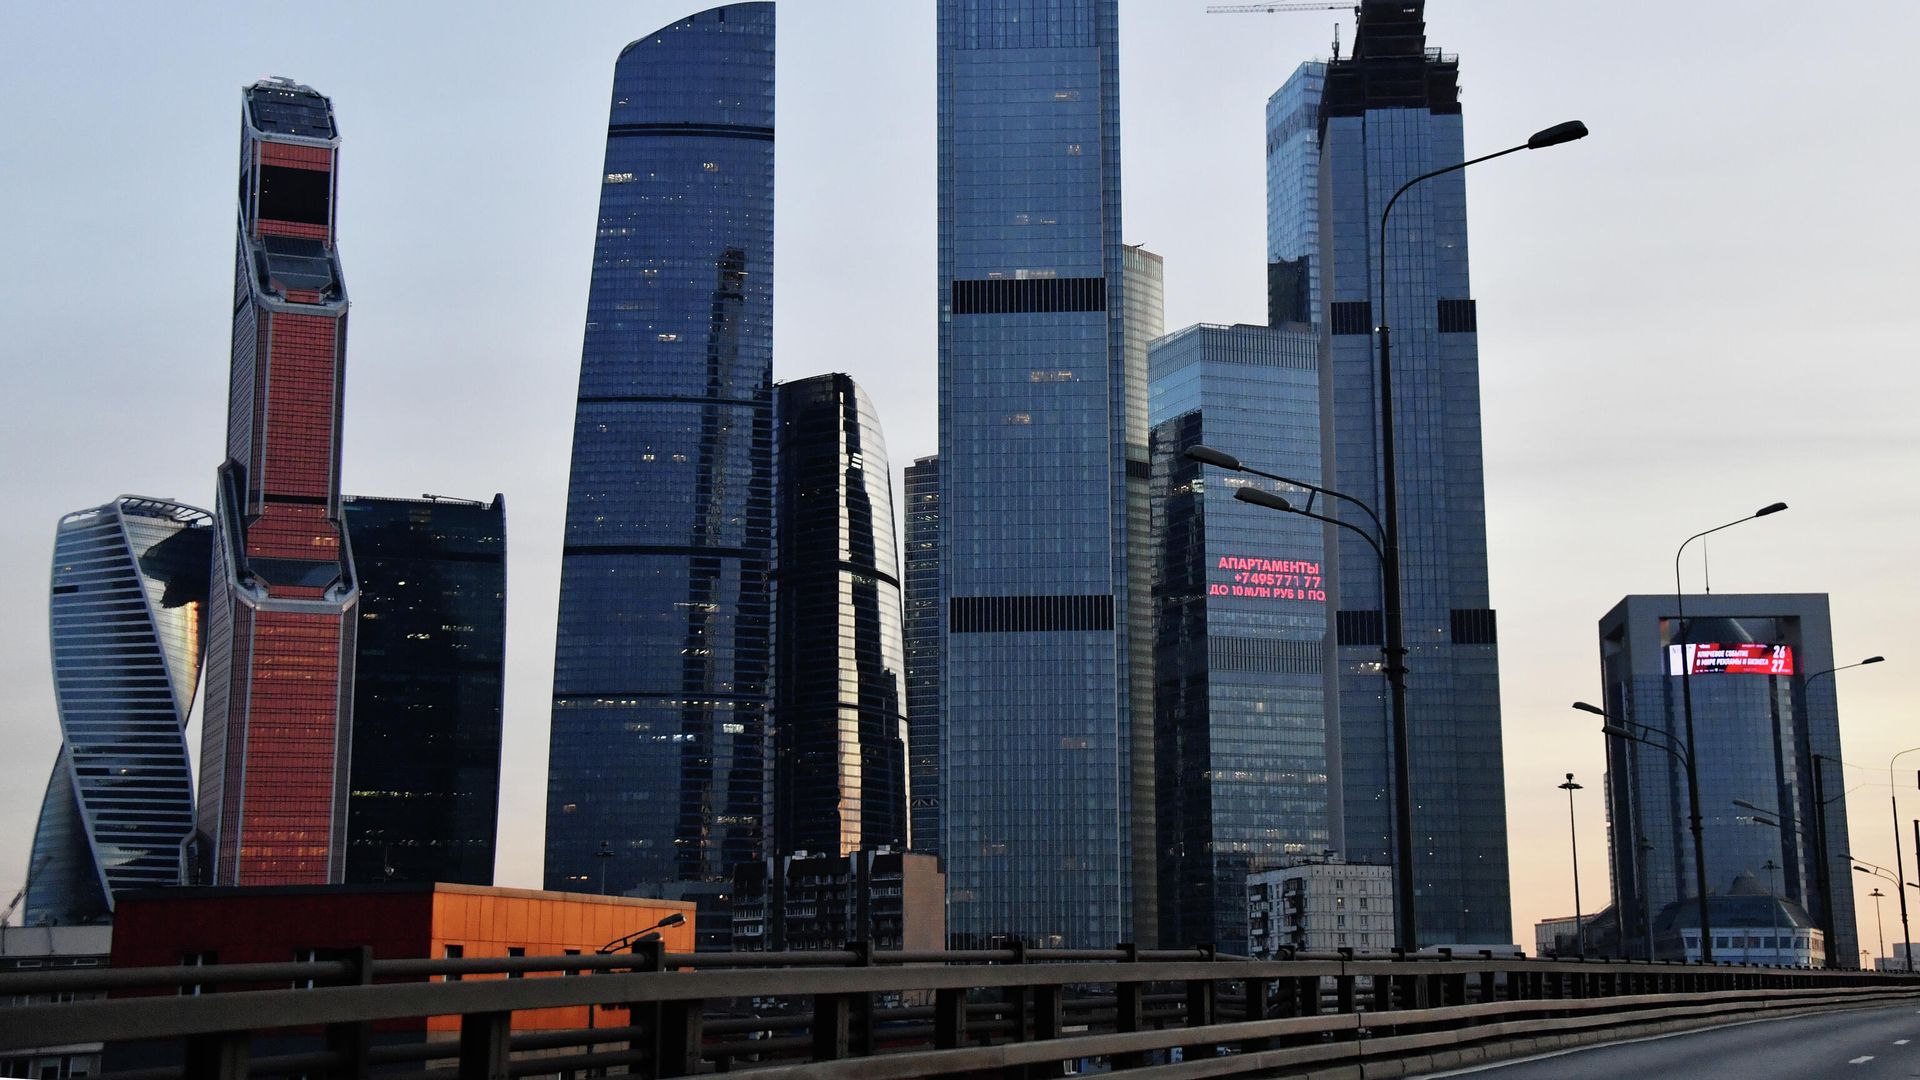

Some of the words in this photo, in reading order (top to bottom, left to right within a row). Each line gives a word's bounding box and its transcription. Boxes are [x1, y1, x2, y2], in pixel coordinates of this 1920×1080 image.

[1219, 557, 1319, 574] АПАРТАМЕНТЫ
[1210, 584, 1228, 595] ДО
[1274, 588, 1294, 599] РУБ
[1298, 589, 1304, 600] В
[1773, 645, 1786, 659] 26
[1771, 660, 1785, 673] 27
